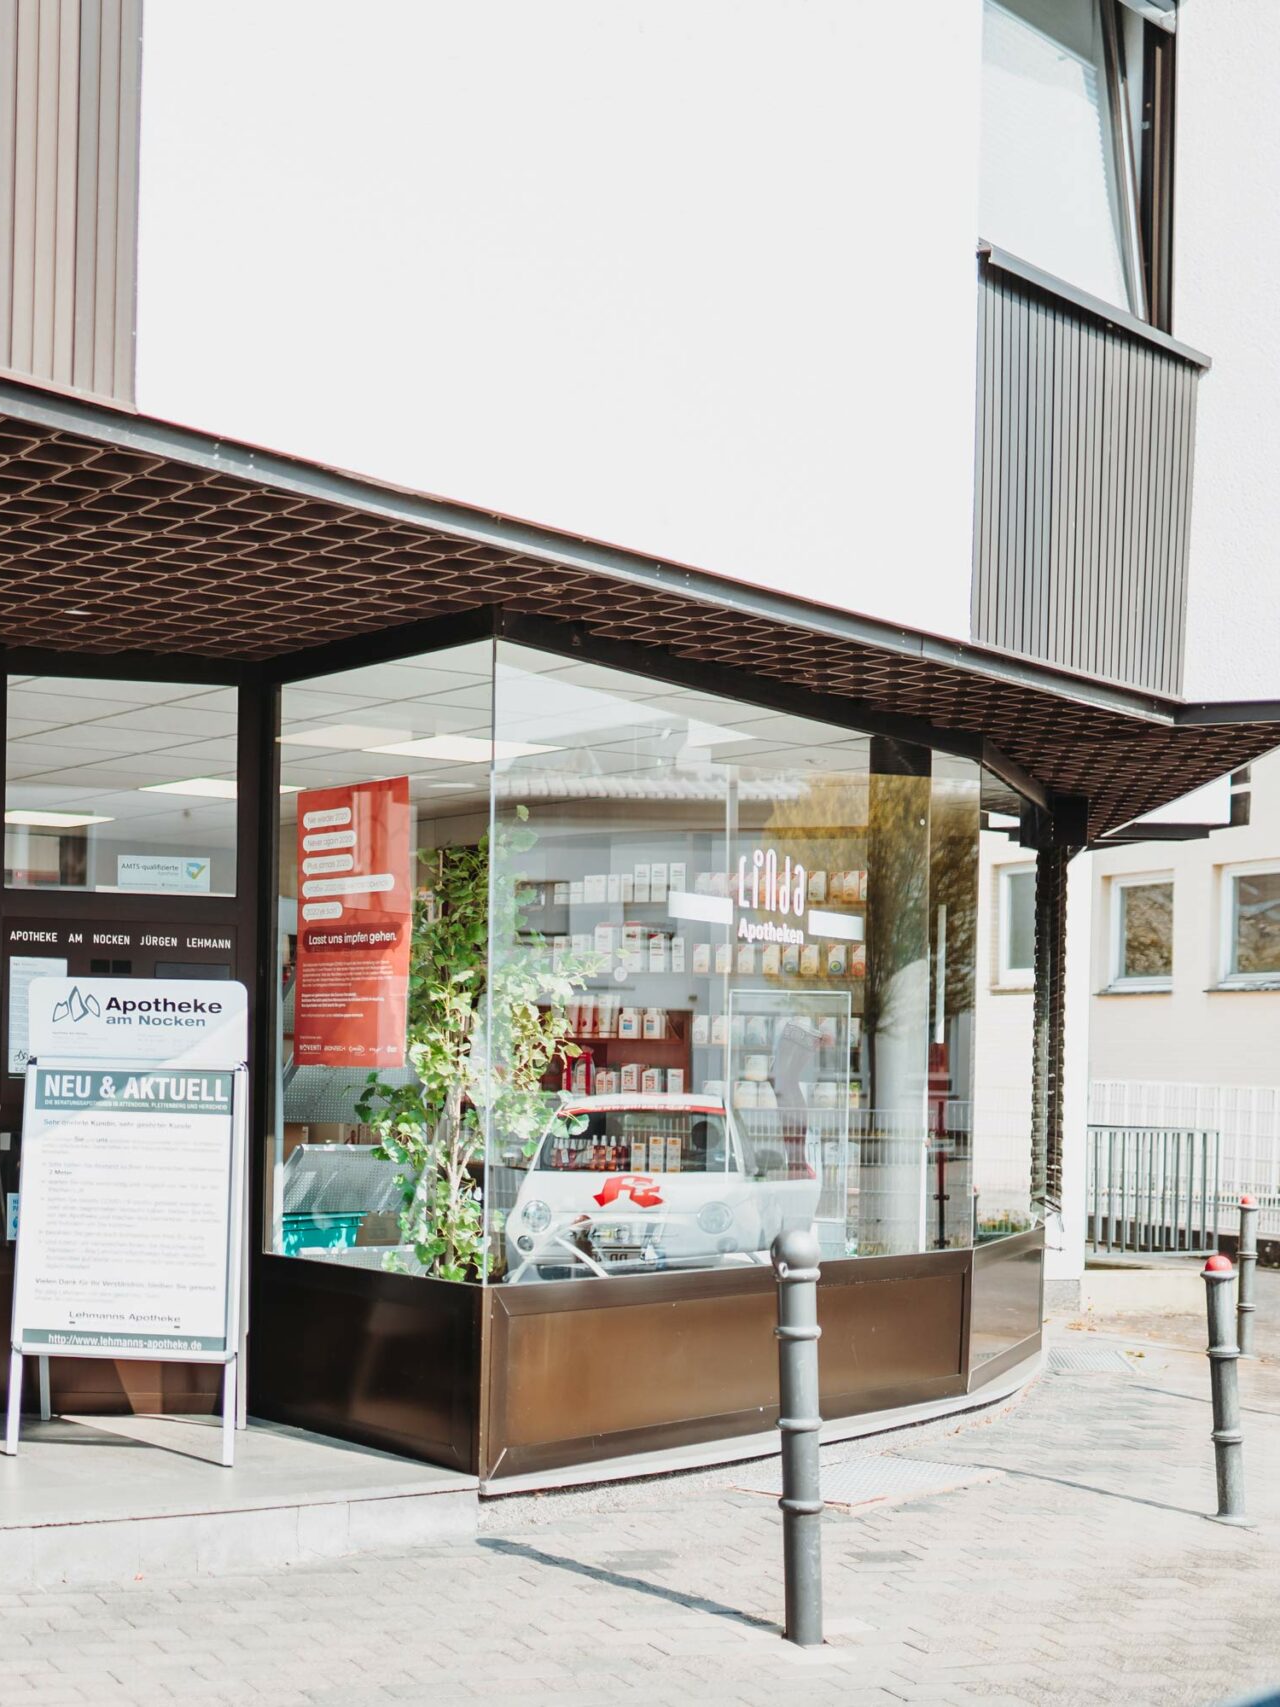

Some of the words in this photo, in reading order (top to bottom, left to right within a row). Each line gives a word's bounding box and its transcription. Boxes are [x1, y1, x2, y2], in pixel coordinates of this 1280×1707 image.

[10, 930, 58, 943] APOTHEKE
[68, 933, 82, 944] AM
[93, 934, 130, 945] NOCKEN
[140, 934, 178, 947] JÜRGEN
[186, 938, 231, 949] LEHMANN
[309, 935, 327, 945] Lasst
[328, 935, 343, 945] uns
[344, 931, 368, 946] impfen
[369, 931, 397, 945] gehen.
[738, 917, 804, 944] Apotheken
[105, 996, 223, 1015] Apotheke
[106, 1015, 132, 1026] am
[138, 1015, 206, 1028] Nocken
[45, 1074, 91, 1098] NEU
[100, 1076, 116, 1099] &
[123, 1077, 229, 1102] AKTUELL
[69, 1310, 125, 1321] Lehmanns
[128, 1312, 181, 1323] Apotheke
[48, 1333, 202, 1350] http://www.lehmanns-apotheke.de
